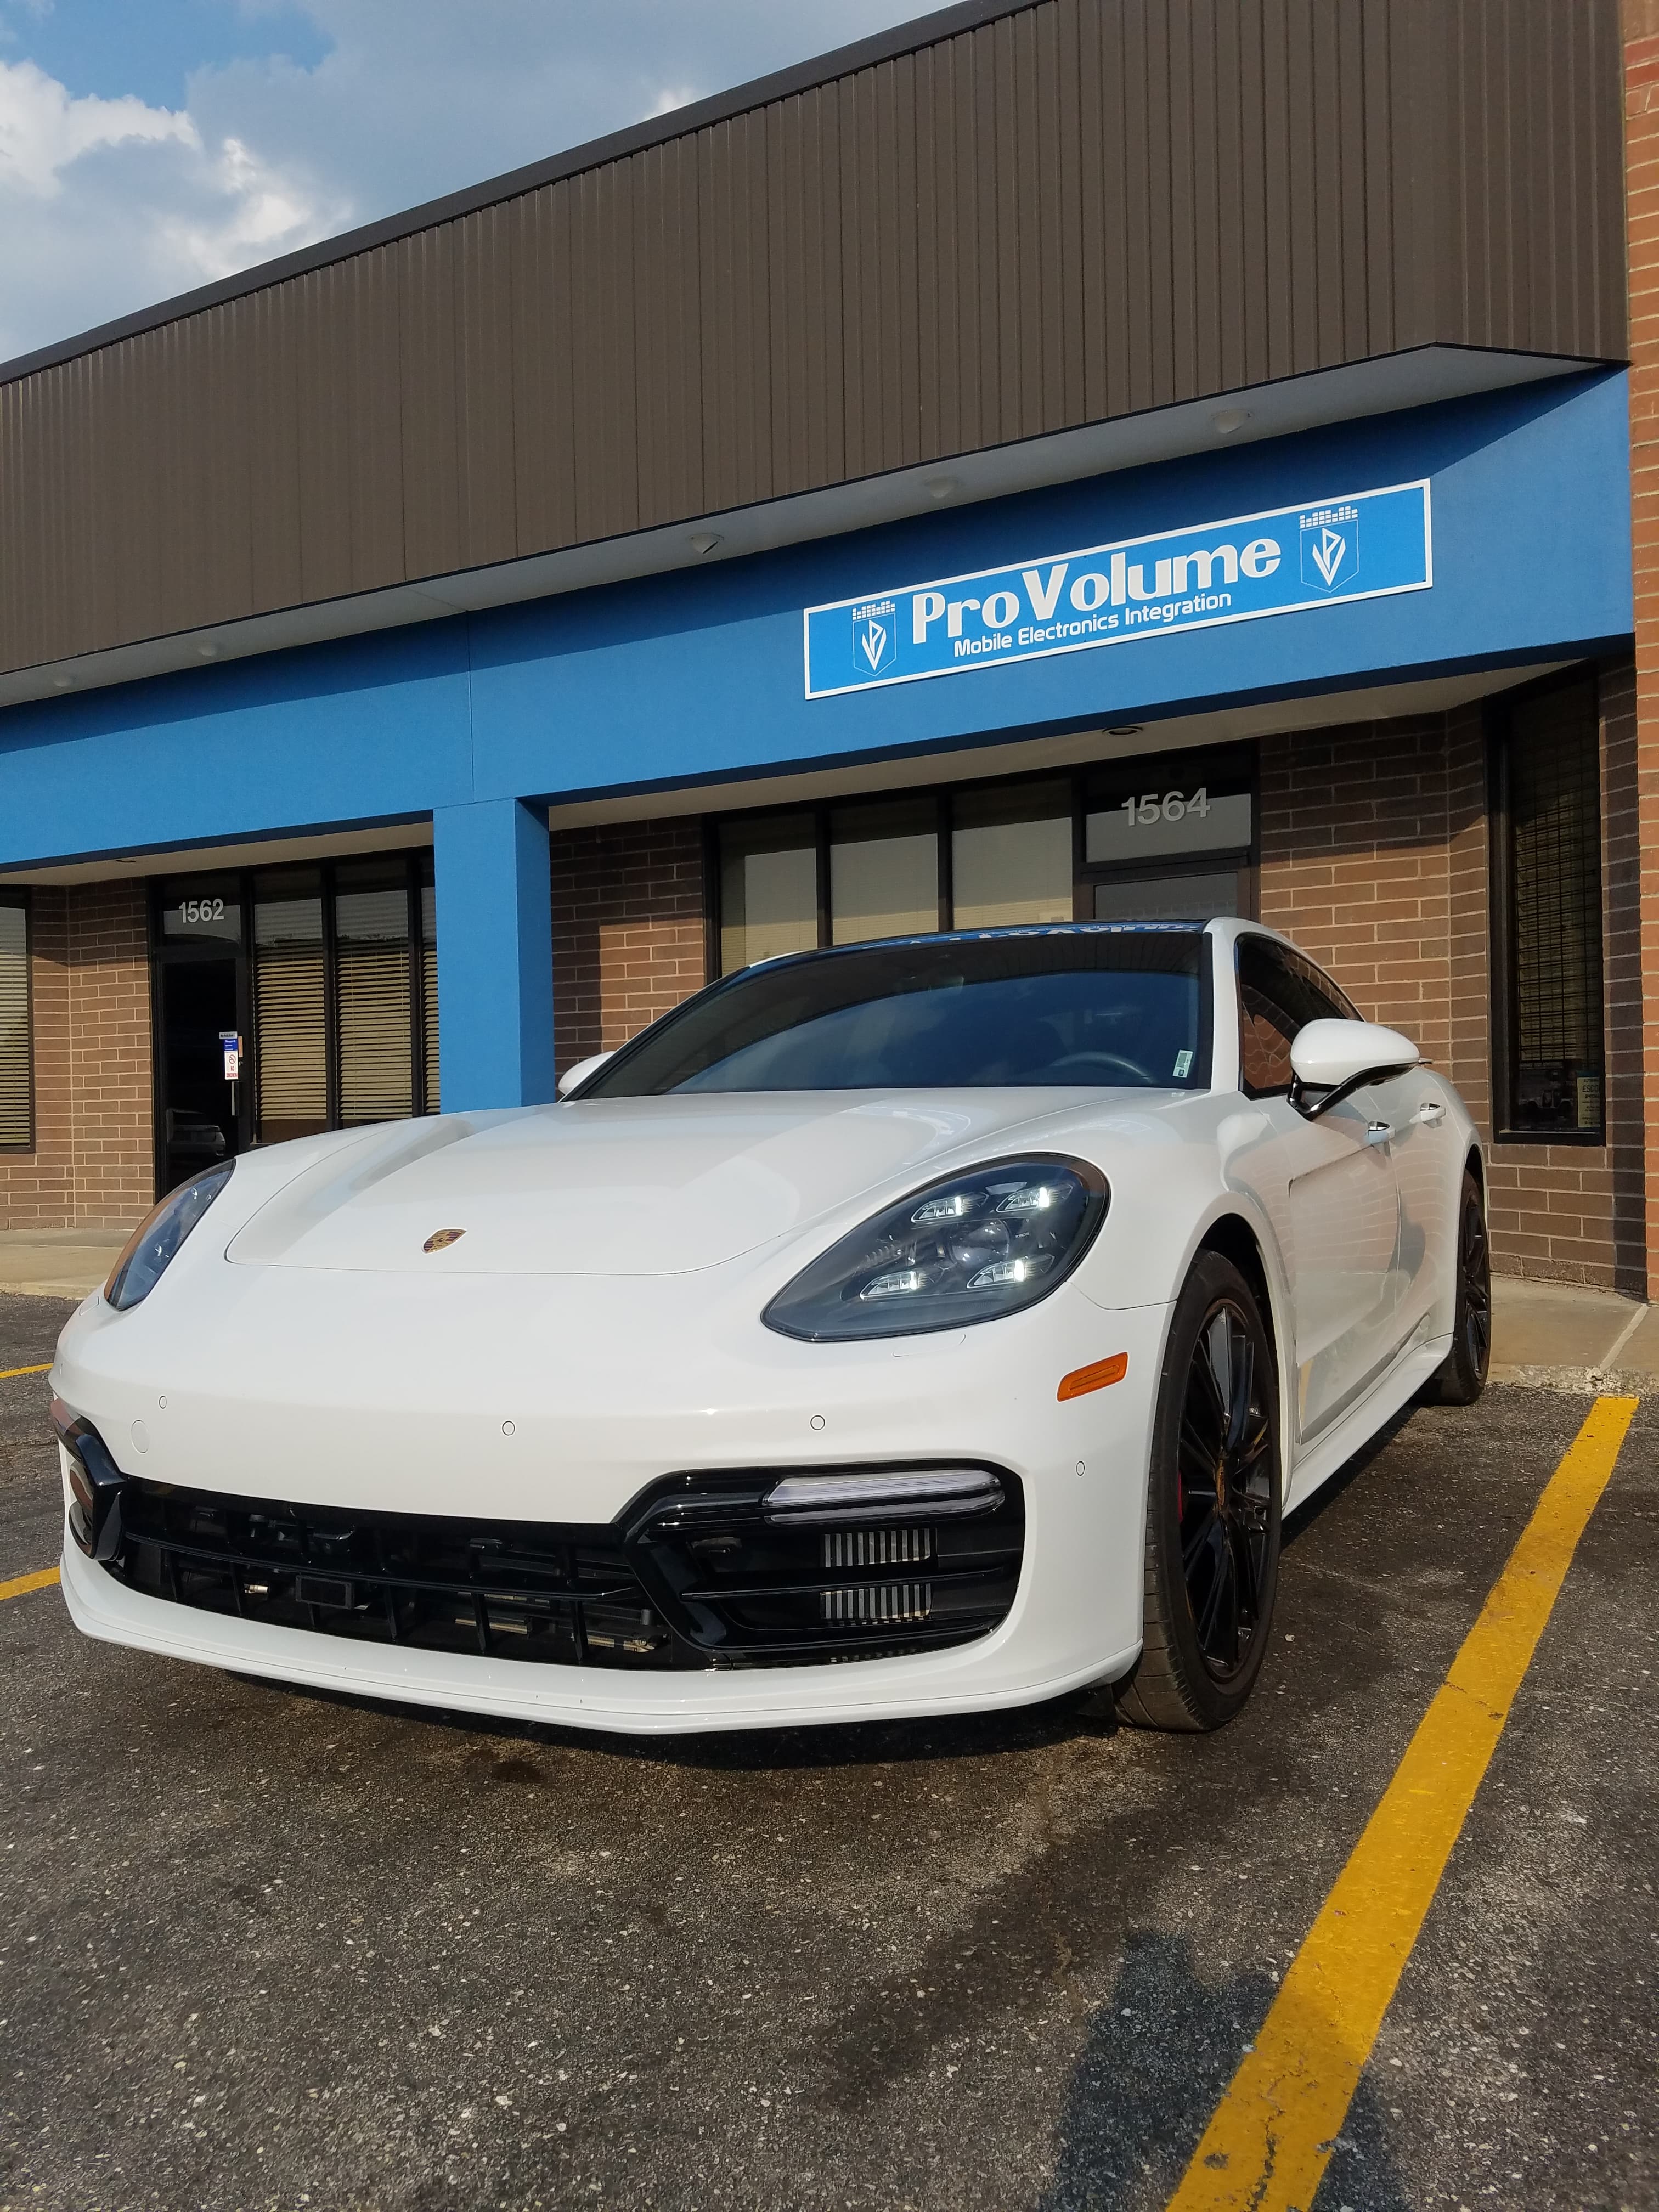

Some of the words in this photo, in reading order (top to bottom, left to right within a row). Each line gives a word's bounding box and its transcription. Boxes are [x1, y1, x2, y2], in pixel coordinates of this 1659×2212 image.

[912, 538, 1281, 645] ProVolume
[953, 631, 1013, 658] Mobile
[1018, 613, 1119, 646] Electronics
[1125, 592, 1231, 625] Integration
[1121, 787, 1211, 827] 1564
[178, 899, 224, 924] 1562
